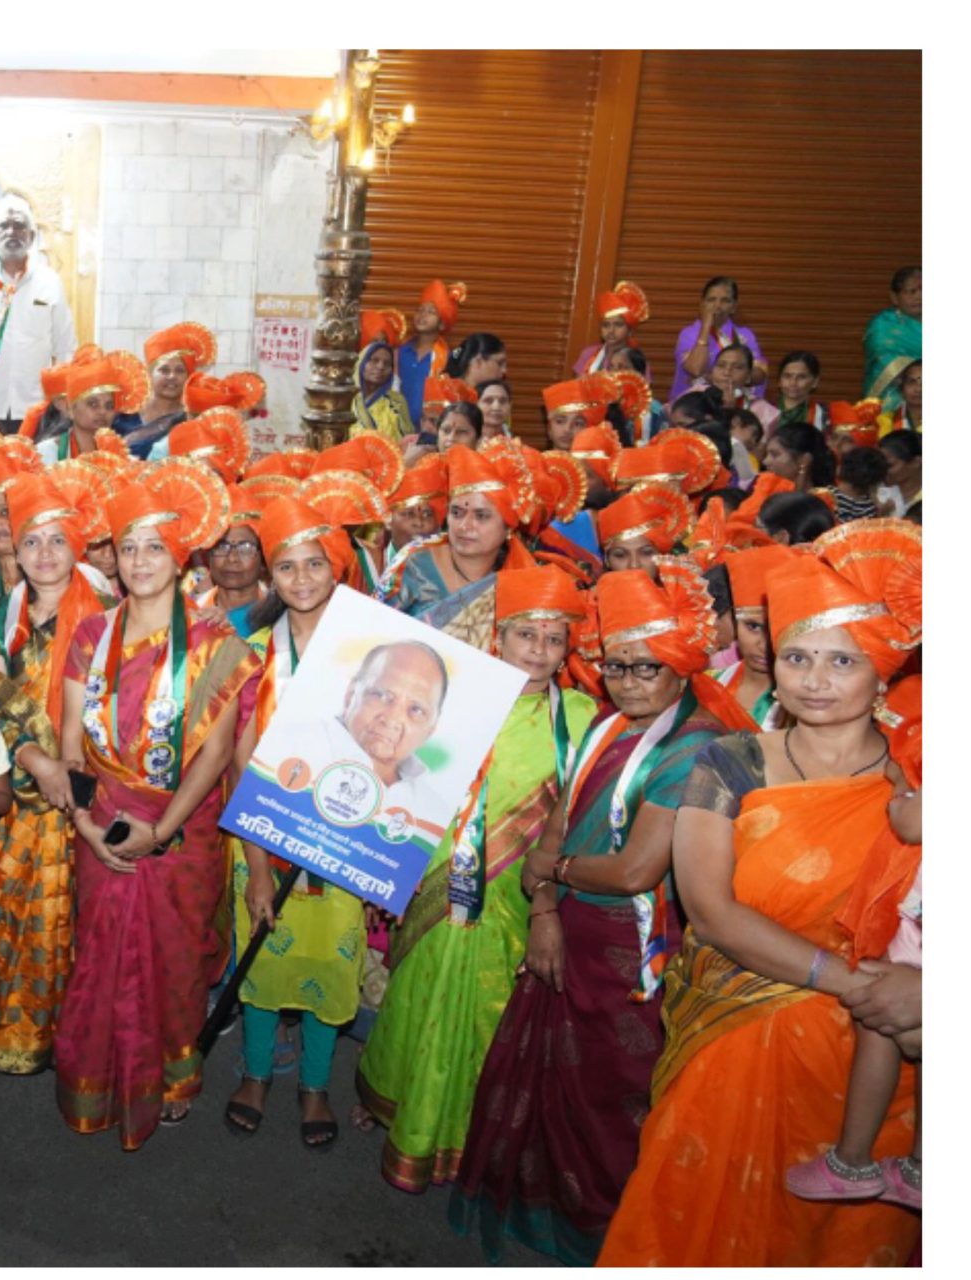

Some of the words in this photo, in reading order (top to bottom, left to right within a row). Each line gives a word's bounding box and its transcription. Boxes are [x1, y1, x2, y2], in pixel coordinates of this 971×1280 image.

[235, 812, 286, 846] अजित
[284, 834, 344, 875] दामोदर
[341, 862, 397, 900] गव्हाणे
